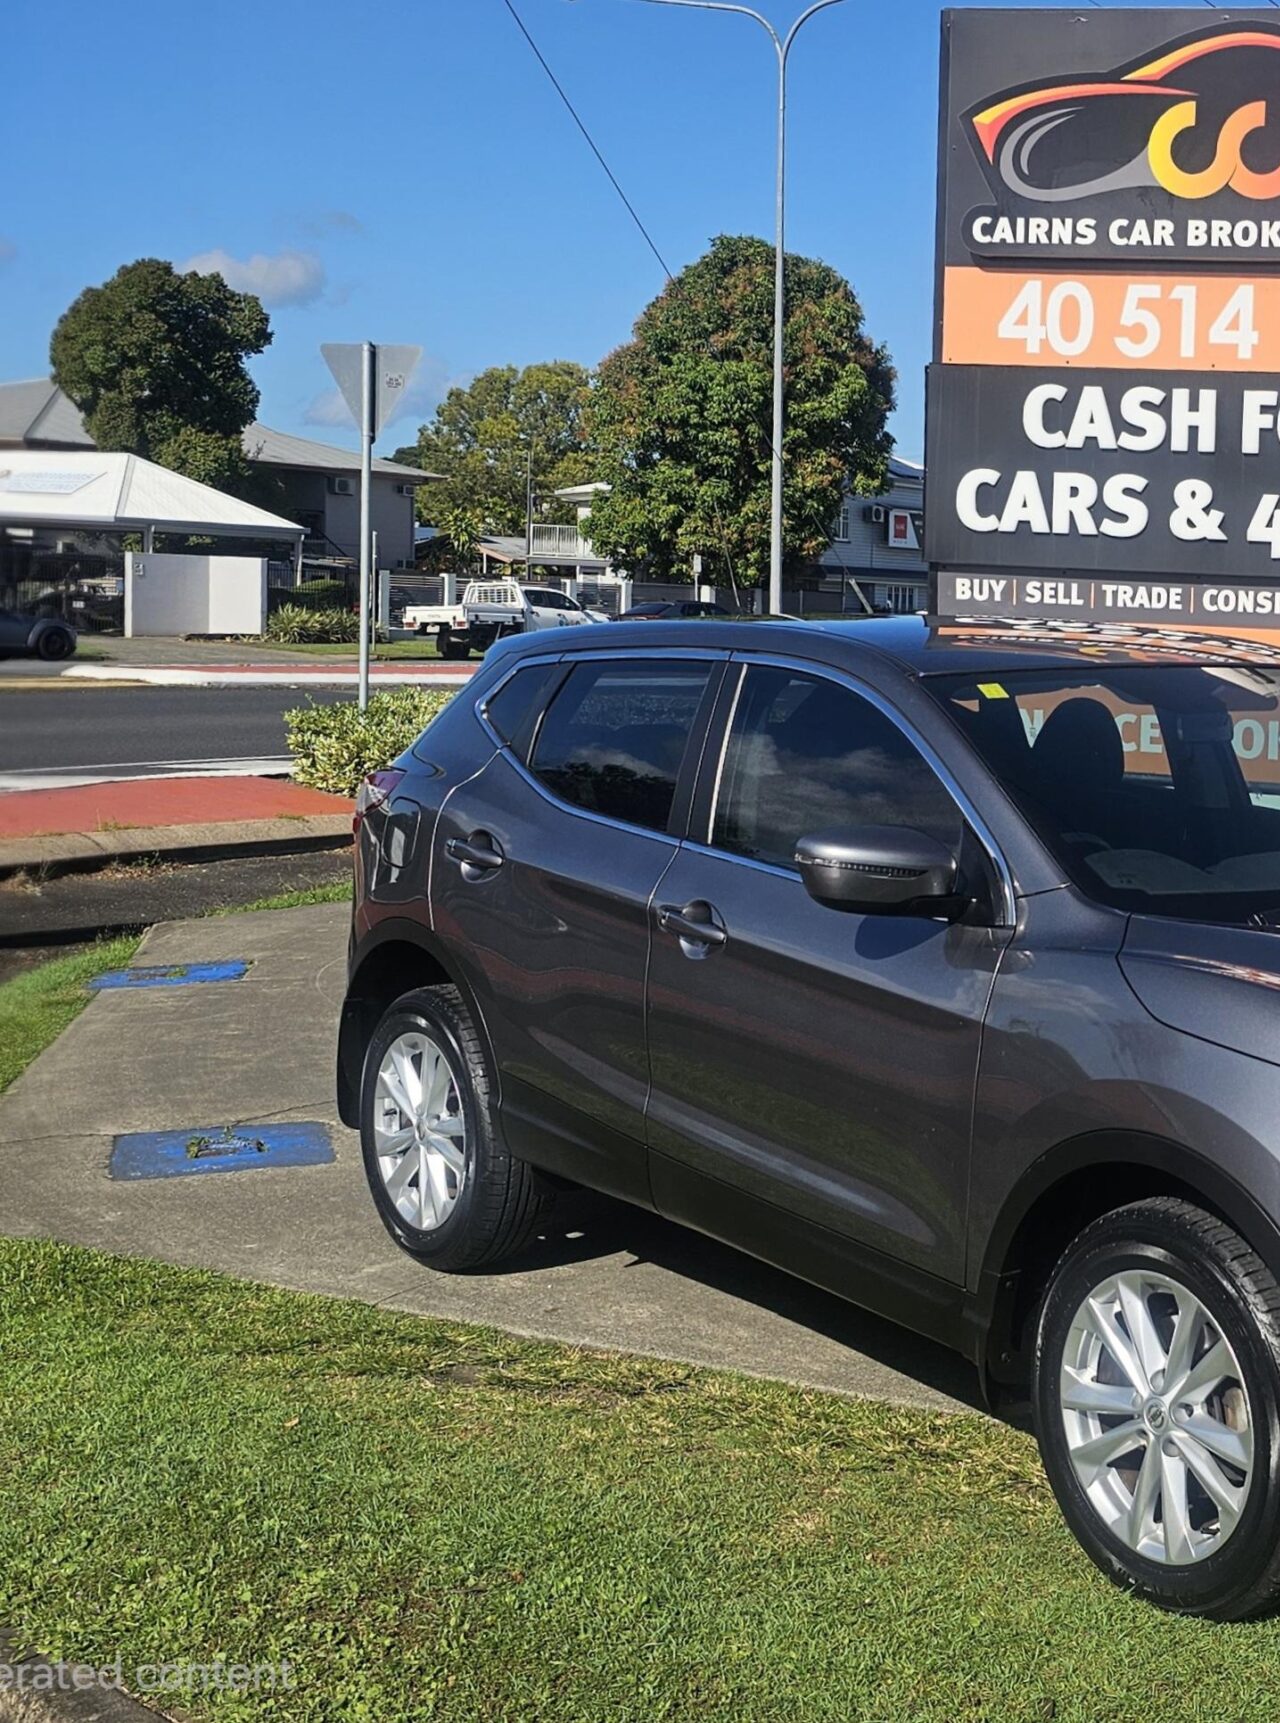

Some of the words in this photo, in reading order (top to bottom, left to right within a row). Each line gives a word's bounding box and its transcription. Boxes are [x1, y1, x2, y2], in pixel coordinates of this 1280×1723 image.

[972, 215, 1097, 246] CAIRNS
[1108, 218, 1175, 248] CAR
[998, 280, 1094, 356] 40
[1113, 284, 1259, 360] 514
[1022, 384, 1217, 453] CASH
[955, 468, 1149, 539] CARS
[1169, 478, 1228, 542] &
[955, 579, 1007, 602] BUY
[1025, 582, 1084, 606] SELL
[1102, 585, 1183, 610] TRADE
